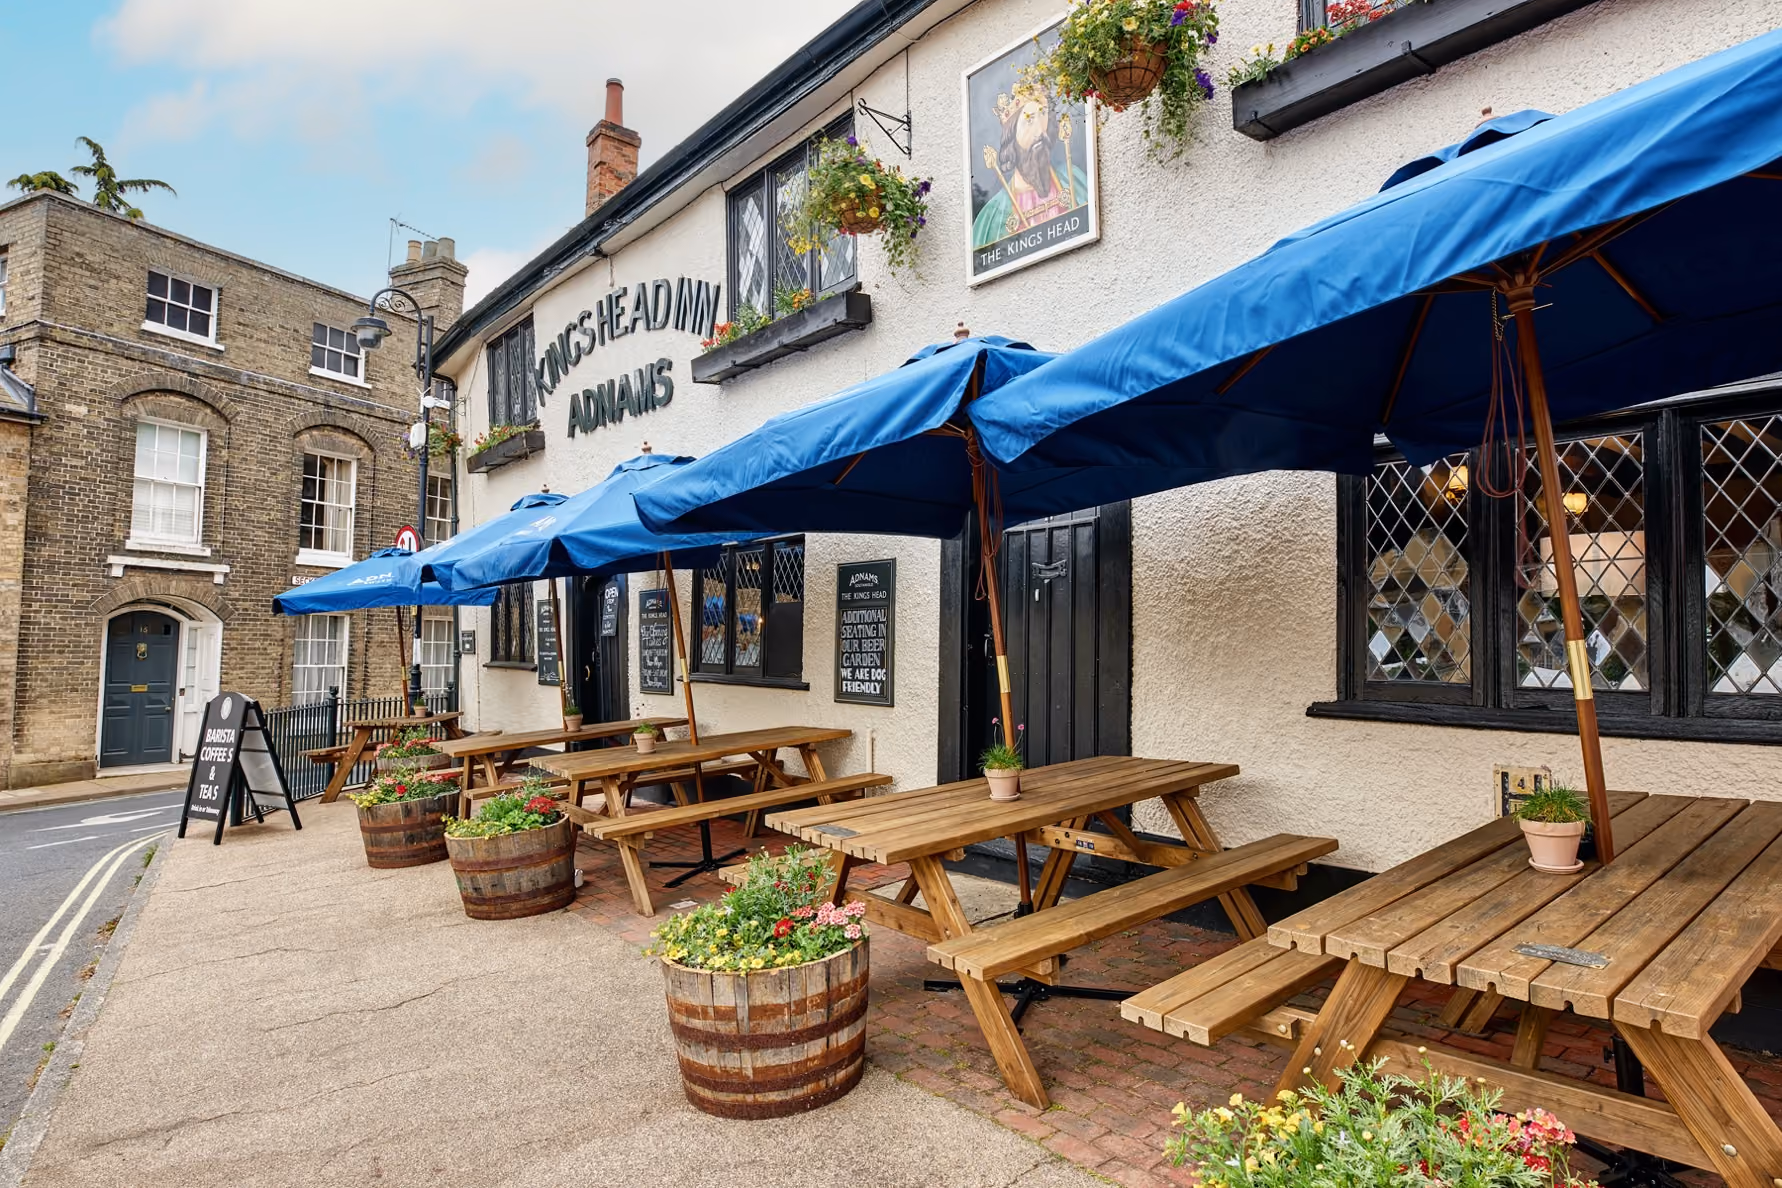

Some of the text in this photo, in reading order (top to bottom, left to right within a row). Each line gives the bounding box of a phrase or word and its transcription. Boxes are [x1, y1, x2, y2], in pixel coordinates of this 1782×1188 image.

[981, 216, 1080, 266] THE KINGS HEAD
[534, 310, 597, 408] KINGS
[567, 357, 675, 439] ADNAMS
[849, 572, 879, 587] ADNAMS
[841, 590, 887, 600] THE KINGS HEAD
[842, 609, 887, 624] ADDITIONAL
[841, 623, 887, 638] SEATING IN
[841, 638, 886, 653] OUR BEER
[842, 652, 881, 667] GARDEN
[841, 667, 887, 681] WE ARE DOG
[842, 681, 882, 694] FRIENDLY
[205, 728, 236, 743] BARISTA
[209, 765, 216, 781] &
